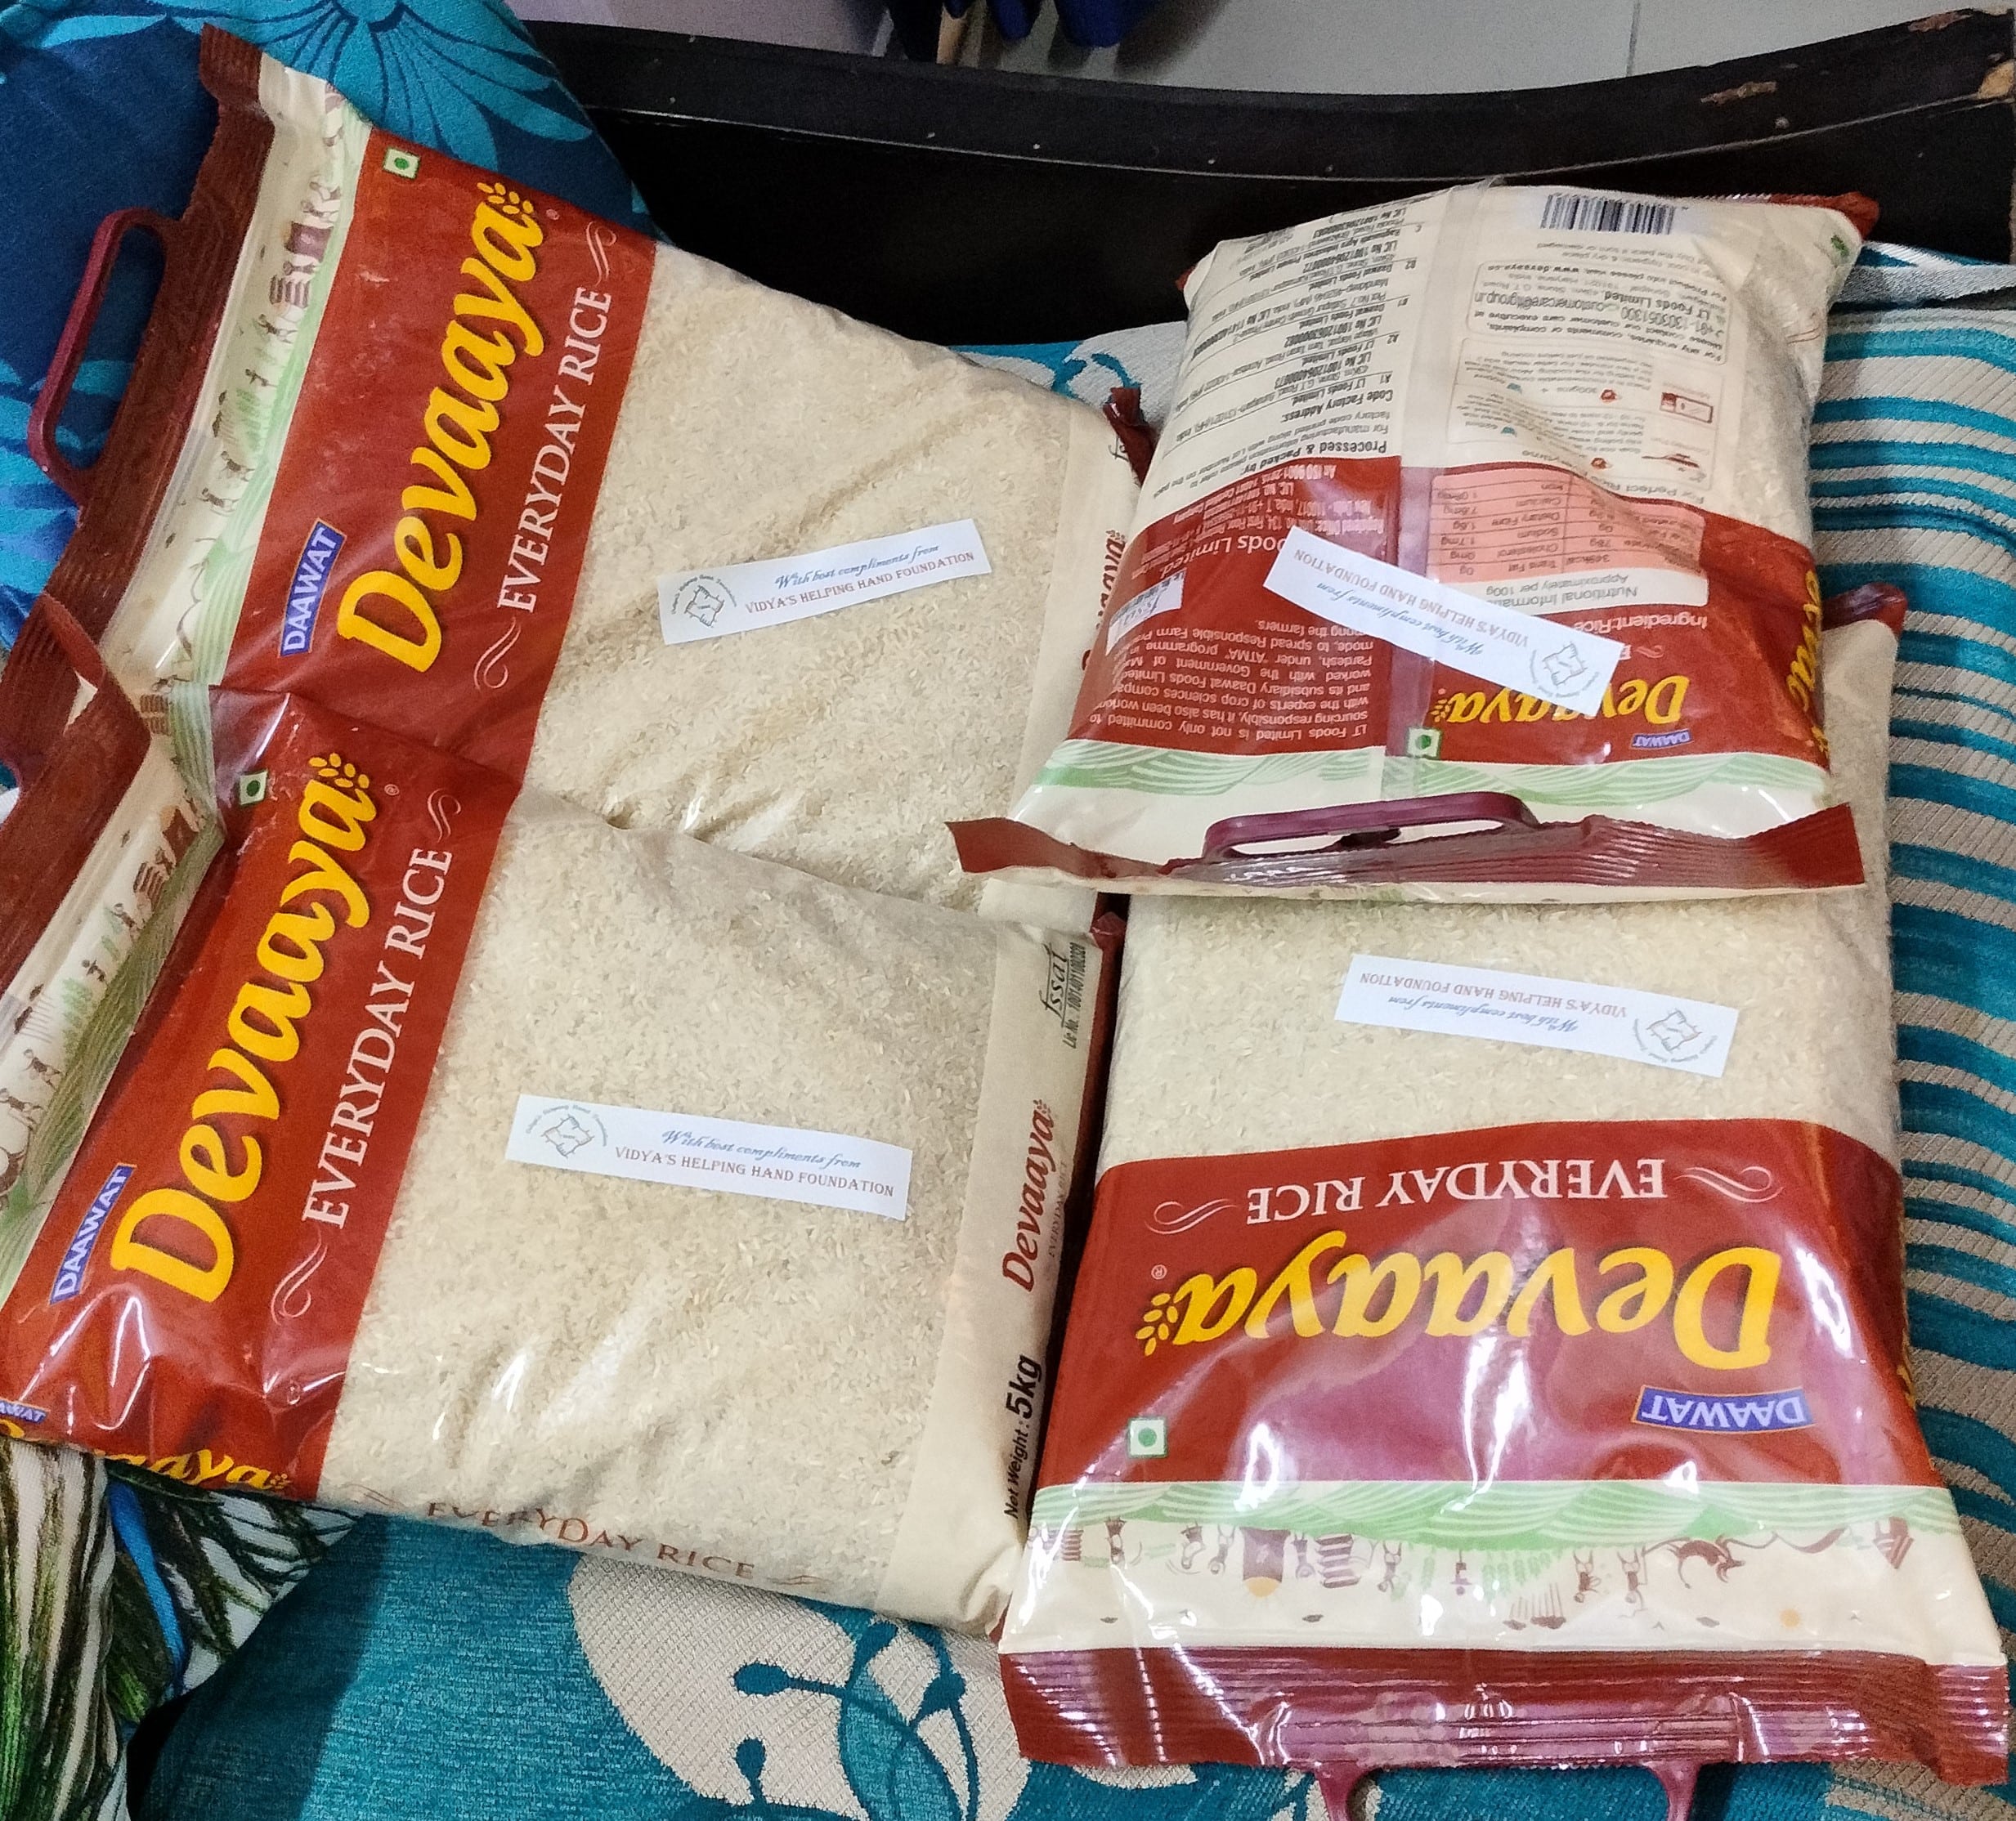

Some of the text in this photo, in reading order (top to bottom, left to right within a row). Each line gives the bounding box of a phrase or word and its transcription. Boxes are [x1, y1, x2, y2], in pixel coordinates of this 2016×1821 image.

[1330, 310, 1353, 321] Foods
[1489, 311, 1539, 322] executive
[1655, 300, 1710, 321] LT Foods
[1570, 315, 1620, 328] customer
[1566, 325, 1622, 339] comments
[1337, 342, 1363, 358] Foods
[1326, 381, 1354, 397] Foods
[1355, 378, 1366, 390] LT
[1324, 393, 1364, 413] Factory
[1367, 390, 1393, 403] Code
[1328, 414, 1352, 425] code
[1355, 410, 1391, 422] factory
[336, 193, 545, 673] Devaaya
[1301, 425, 1369, 442] manufacturing
[1372, 424, 1389, 434] For
[497, 286, 612, 614] EVERYDAY RICE
[1306, 444, 1315, 455] &
[1319, 441, 1387, 454] Processed
[1260, 447, 1301, 470] Packed
[1626, 485, 1678, 497] Perfect
[1521, 512, 1560, 524] Dietary
[1517, 527, 1559, 539] Sodium
[1159, 537, 1232, 578] Limited.
[1497, 544, 1558, 557] Cholesterol
[775, 572, 808, 589] With
[838, 553, 910, 579] compliments
[911, 544, 939, 565] from
[282, 527, 343, 655] DAAWAT
[745, 552, 974, 614] VIDYA'S HELPING HAND FOUNDATION
[1486, 575, 1628, 597] Approximately per 100g
[1293, 548, 1530, 648] VIDYA'S HELPING HAND FOUNDATION
[1315, 583, 1349, 603] from
[1486, 586, 1637, 608] Nutritional Informa
[1345, 596, 1423, 629] compliments
[1255, 620, 1328, 638] the farmers.
[1145, 641, 1219, 657] programme
[1157, 627, 1374, 654] mode, to spread Responsible Farm
[1445, 633, 1483, 655] With
[1153, 655, 1167, 668] of
[1176, 657, 1251, 678] Government
[1275, 654, 1311, 665] under
[1319, 655, 1373, 669] Pardesh,
[1169, 672, 1207, 688] Foods
[1210, 677, 1257, 692] Daawat
[1260, 669, 1279, 682] the
[1289, 670, 1315, 682] with
[1325, 669, 1372, 682] worked
[1261, 681, 1324, 697] subsidiary
[1329, 685, 1343, 697] its
[1347, 682, 1371, 696] and
[1163, 688, 1369, 713] with the experts of crop sciences
[1446, 675, 1690, 725] Devaya
[1142, 700, 1368, 727] sourcing responsibly, it has also been
[1089, 714, 1367, 740] LT Foods Limited is not only committed to
[1633, 732, 1690, 746] DAAWAT
[1360, 973, 1628, 1018] VIDYA'S HELPING HAND FOUNDATION
[1388, 996, 1426, 1012] from
[1423, 999, 1506, 1017] compliments
[1538, 1015, 1579, 1032] With
[110, 768, 377, 1303] Devaaya
[302, 848, 453, 1229] EVERYDAY RICE
[662, 1129, 705, 1149] With
[736, 1143, 825, 1165] compliments
[824, 1152, 862, 1170] from
[615, 1147, 894, 1198] VIDYA'S HELPING HAND FOUNDATION
[1002, 1103, 1056, 1292] Devaaya
[1246, 1158, 1667, 1224] EVERYDAY RICE
[54, 1168, 128, 1300] DAAWAT
[1169, 1230, 1782, 1371] Devaaya
[1006, 1353, 1042, 1420] 5kg
[1640, 1392, 1803, 1433] DAAWAT
[1003, 1487, 1020, 1519] Net
[657, 1543, 755, 1579] RICE
